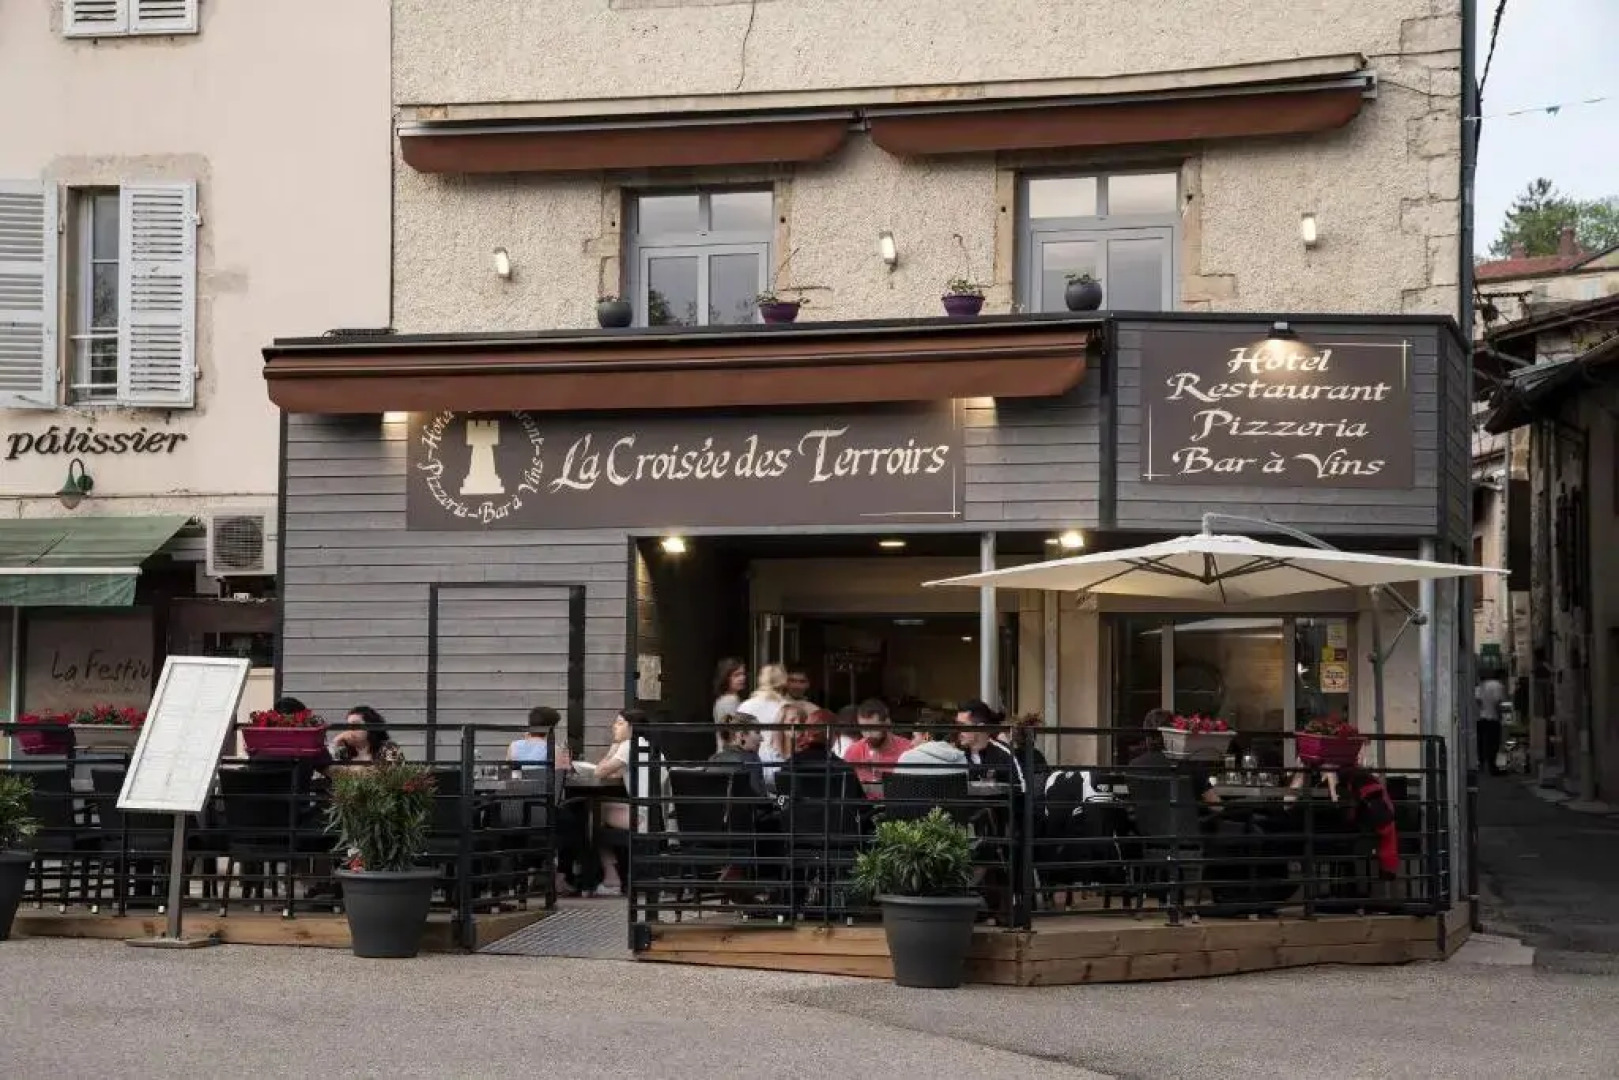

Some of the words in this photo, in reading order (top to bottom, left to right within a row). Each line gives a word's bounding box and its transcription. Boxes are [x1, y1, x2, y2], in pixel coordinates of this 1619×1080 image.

[1166, 372, 1391, 403] Restaurant
[1189, 408, 1369, 442] Pizzeria
[549, 433, 601, 494] La
[606, 433, 731, 487] Croisée
[734, 434, 792, 478] des
[798, 424, 949, 483] Terroirs
[1172, 447, 1257, 475] Bar
[1262, 451, 1286, 473] à
[1291, 448, 1386, 478] Vins
[51, 650, 78, 681] La
